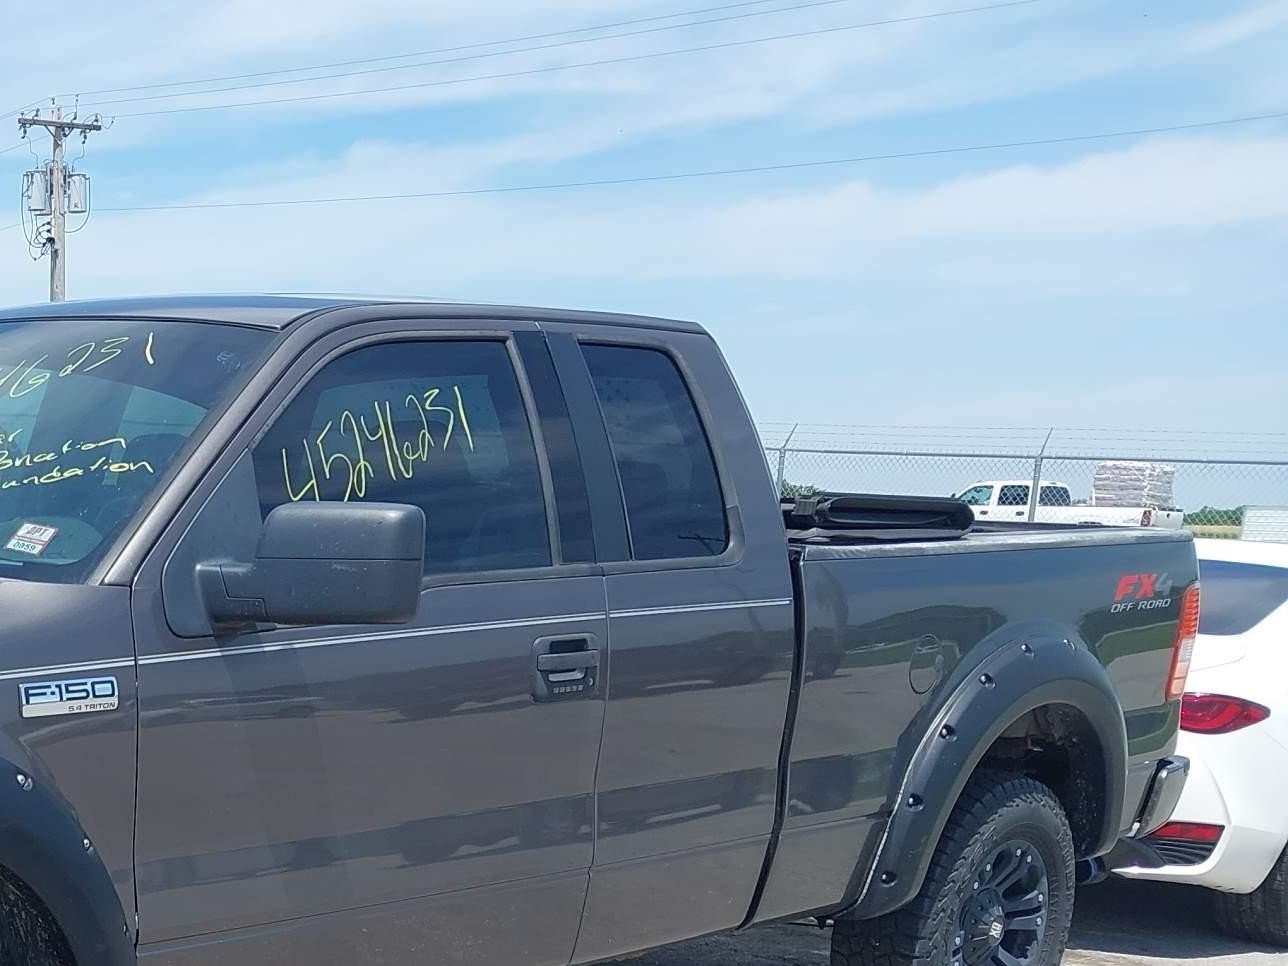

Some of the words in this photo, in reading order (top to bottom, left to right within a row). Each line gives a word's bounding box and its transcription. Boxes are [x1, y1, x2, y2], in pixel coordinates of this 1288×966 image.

[281, 385, 474, 502] 45246231
[1113, 572, 1173, 601] FX4
[1110, 601, 1136, 613] OFF
[1137, 598, 1172, 610] ROAD
[23, 680, 116, 705] F-150
[84, 702, 116, 711] TRITON
